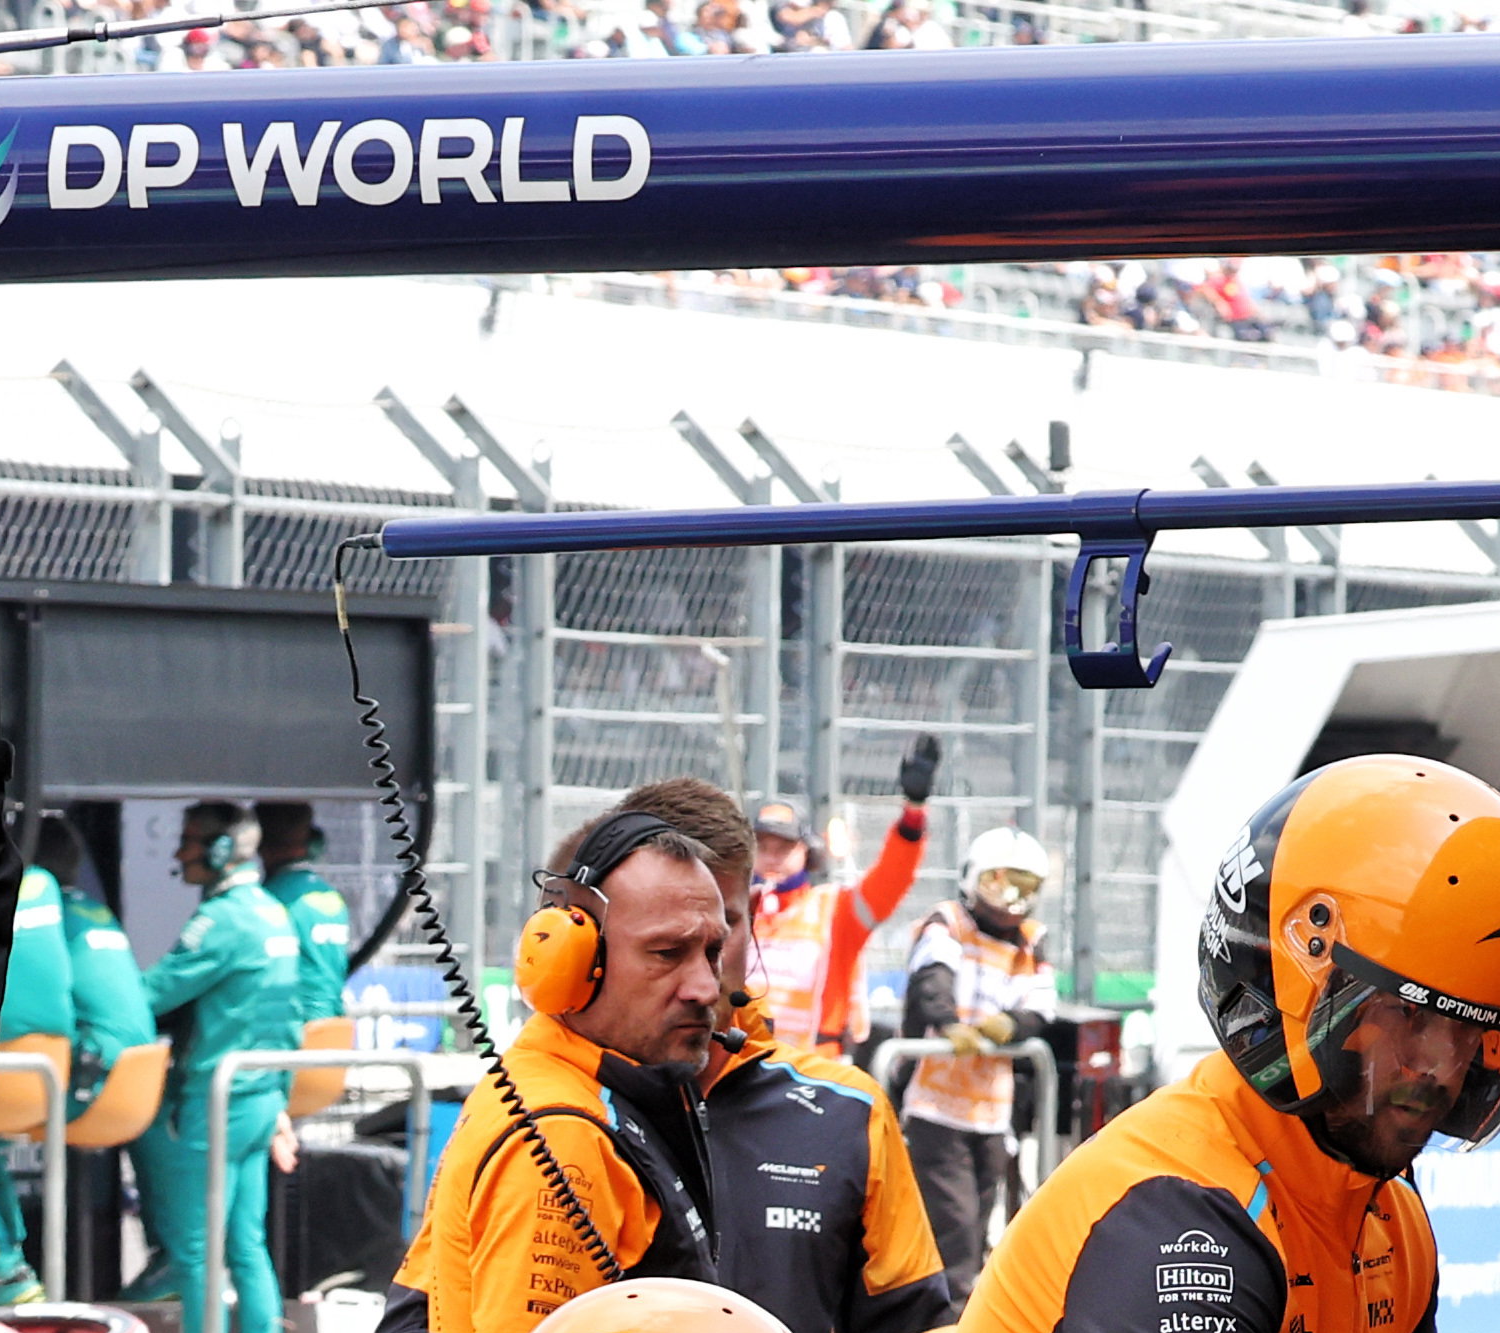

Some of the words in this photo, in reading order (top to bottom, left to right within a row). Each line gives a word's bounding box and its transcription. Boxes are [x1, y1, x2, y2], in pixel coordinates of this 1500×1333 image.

[47, 123, 200, 210] DP
[222, 116, 652, 208] WORLD
[1400, 983, 1430, 1003] ON
[1437, 996, 1497, 1024] OPTIMUM
[757, 1162, 820, 1178] McLaren
[766, 1206, 821, 1234] OKX
[533, 1231, 585, 1254] alteryx
[1160, 1241, 1228, 1258] workday
[532, 1253, 580, 1274] vmware
[1163, 1268, 1227, 1287] Hilton
[1159, 1293, 1178, 1303] FOR
[1182, 1293, 1203, 1301] THE
[1207, 1294, 1232, 1304] STAY
